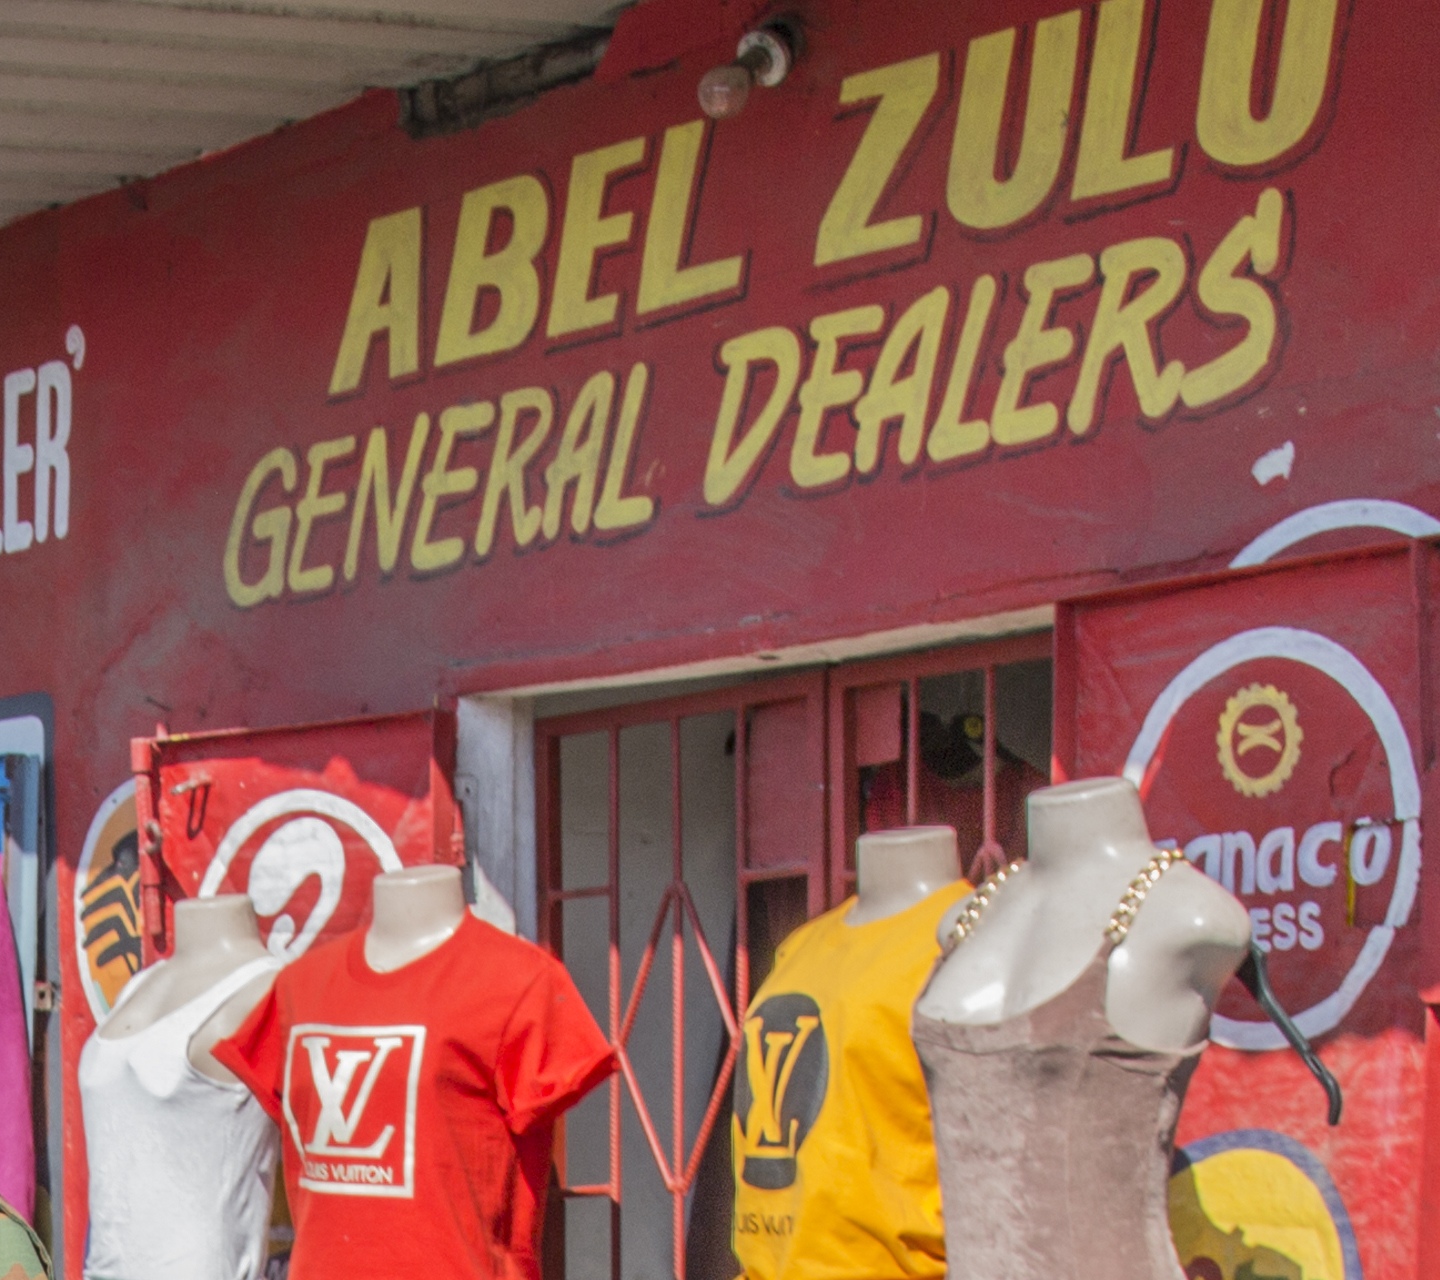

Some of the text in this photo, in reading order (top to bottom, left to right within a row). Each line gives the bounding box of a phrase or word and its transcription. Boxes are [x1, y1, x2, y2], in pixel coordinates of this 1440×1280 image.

[327, 0, 1341, 398] ABEL ZULU
[223, 187, 1285, 609] GENERAL DEALERS
[1153, 821, 1391, 896] anaco
[1250, 901, 1324, 952] ESS
[331, 1164, 393, 1185] VUITTON
